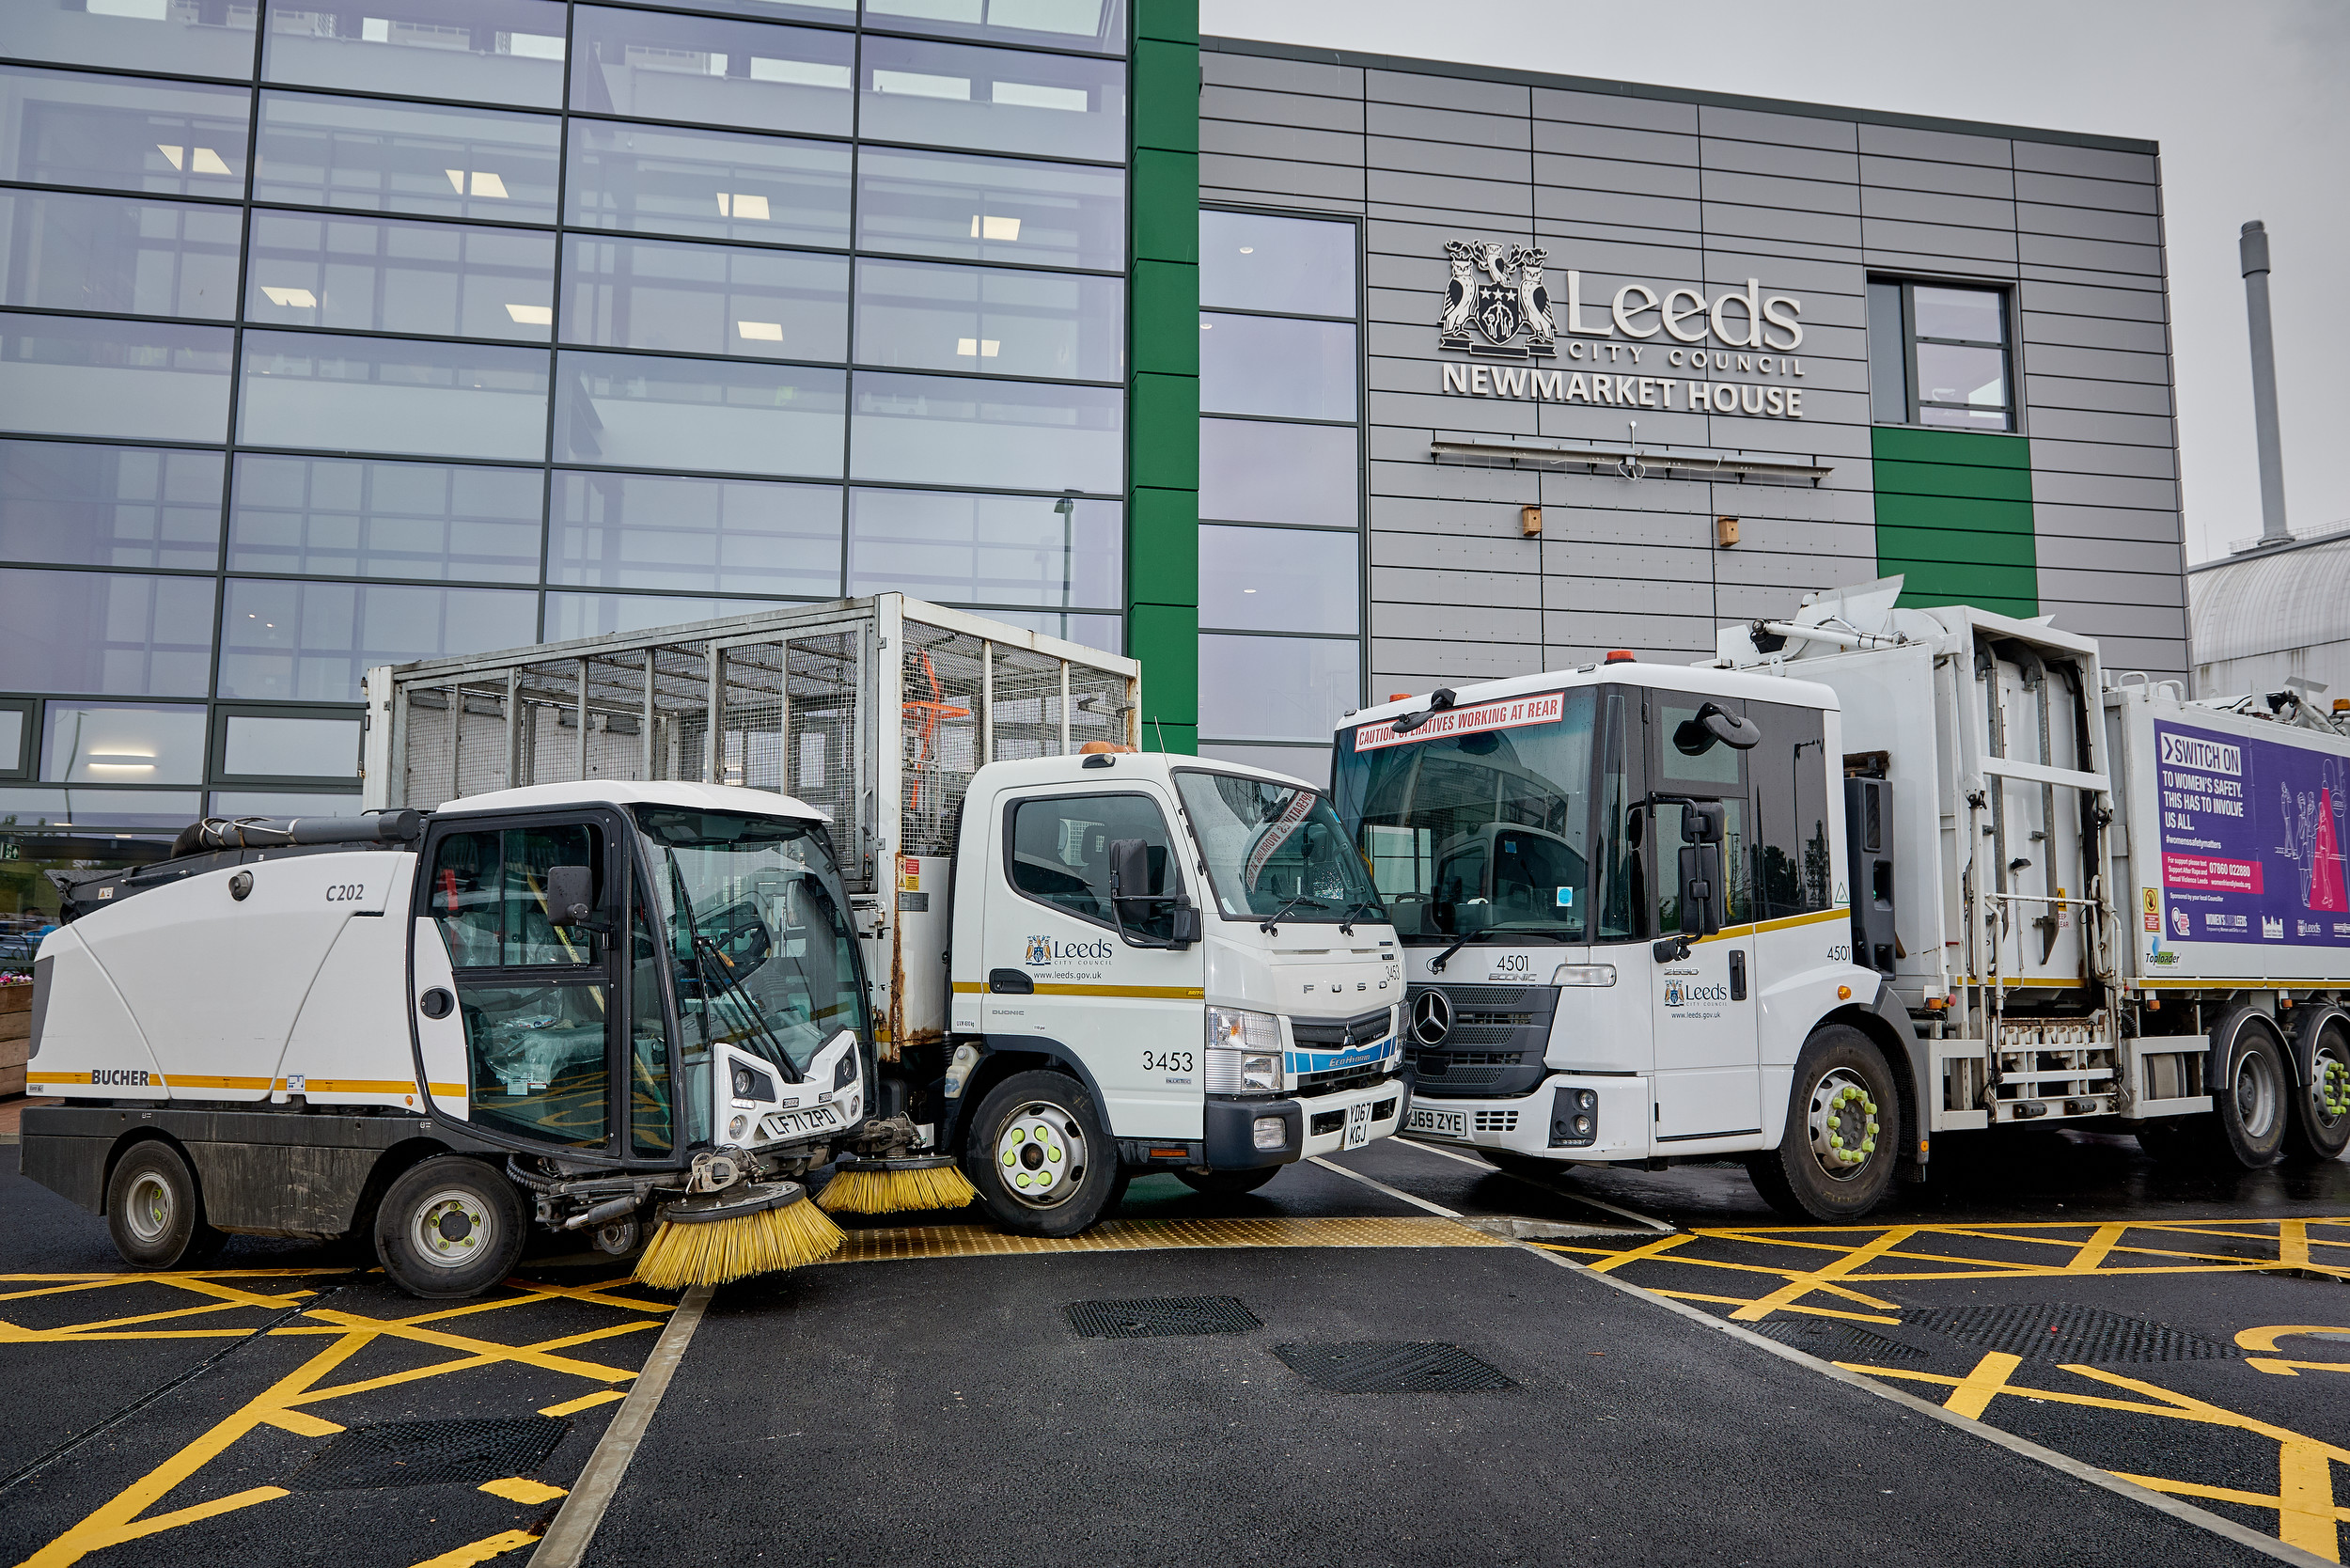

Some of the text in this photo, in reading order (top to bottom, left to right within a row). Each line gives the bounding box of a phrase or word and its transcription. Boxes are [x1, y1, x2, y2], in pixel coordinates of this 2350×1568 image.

[1566, 269, 1804, 352] Leeds
[1569, 341, 1805, 375] CITY COUNCIL
[1442, 362, 1804, 418] NEWMARKET HOUSE
[1358, 726, 1395, 746] CAUTION
[1458, 706, 1508, 729] WORKING
[1511, 703, 1524, 721] AT
[1528, 698, 1559, 718] REAR
[2174, 738, 2239, 773] SWITCH ON
[2162, 770, 2244, 798] TO WOMEN'S SAFETY.
[2163, 791, 2244, 818] THIS HAS TO INVOLVE
[2164, 811, 2195, 831] US ALL.
[2166, 834, 2222, 850] #womenssafetymatters
[2209, 862, 2229, 875] 07860
[326, 884, 364, 902] C202
[2305, 922, 2322, 933] Leeds
[1055, 938, 1113, 959] Leeds
[1826, 945, 1851, 961] 4501
[2145, 951, 2180, 965] Toploader
[1385, 964, 1400, 981] 3453
[1496, 954, 1529, 972] 4501
[1033, 971, 1102, 980] www.leeds.gov.uk
[1488, 973, 1538, 982] ECONIC
[1303, 980, 1388, 995] FUSO
[1685, 982, 1728, 1001] Leeds
[1671, 1011, 1721, 1020] www.leeds.gov.uk
[1142, 1050, 1194, 1073] 3453
[91, 1069, 149, 1087] BUCHER
[767, 1107, 837, 1136] LF71 ZPD
[1350, 1102, 1371, 1124] YD67
[1410, 1110, 1462, 1132] J69 ZYE
[1349, 1123, 1367, 1146] KGJ
